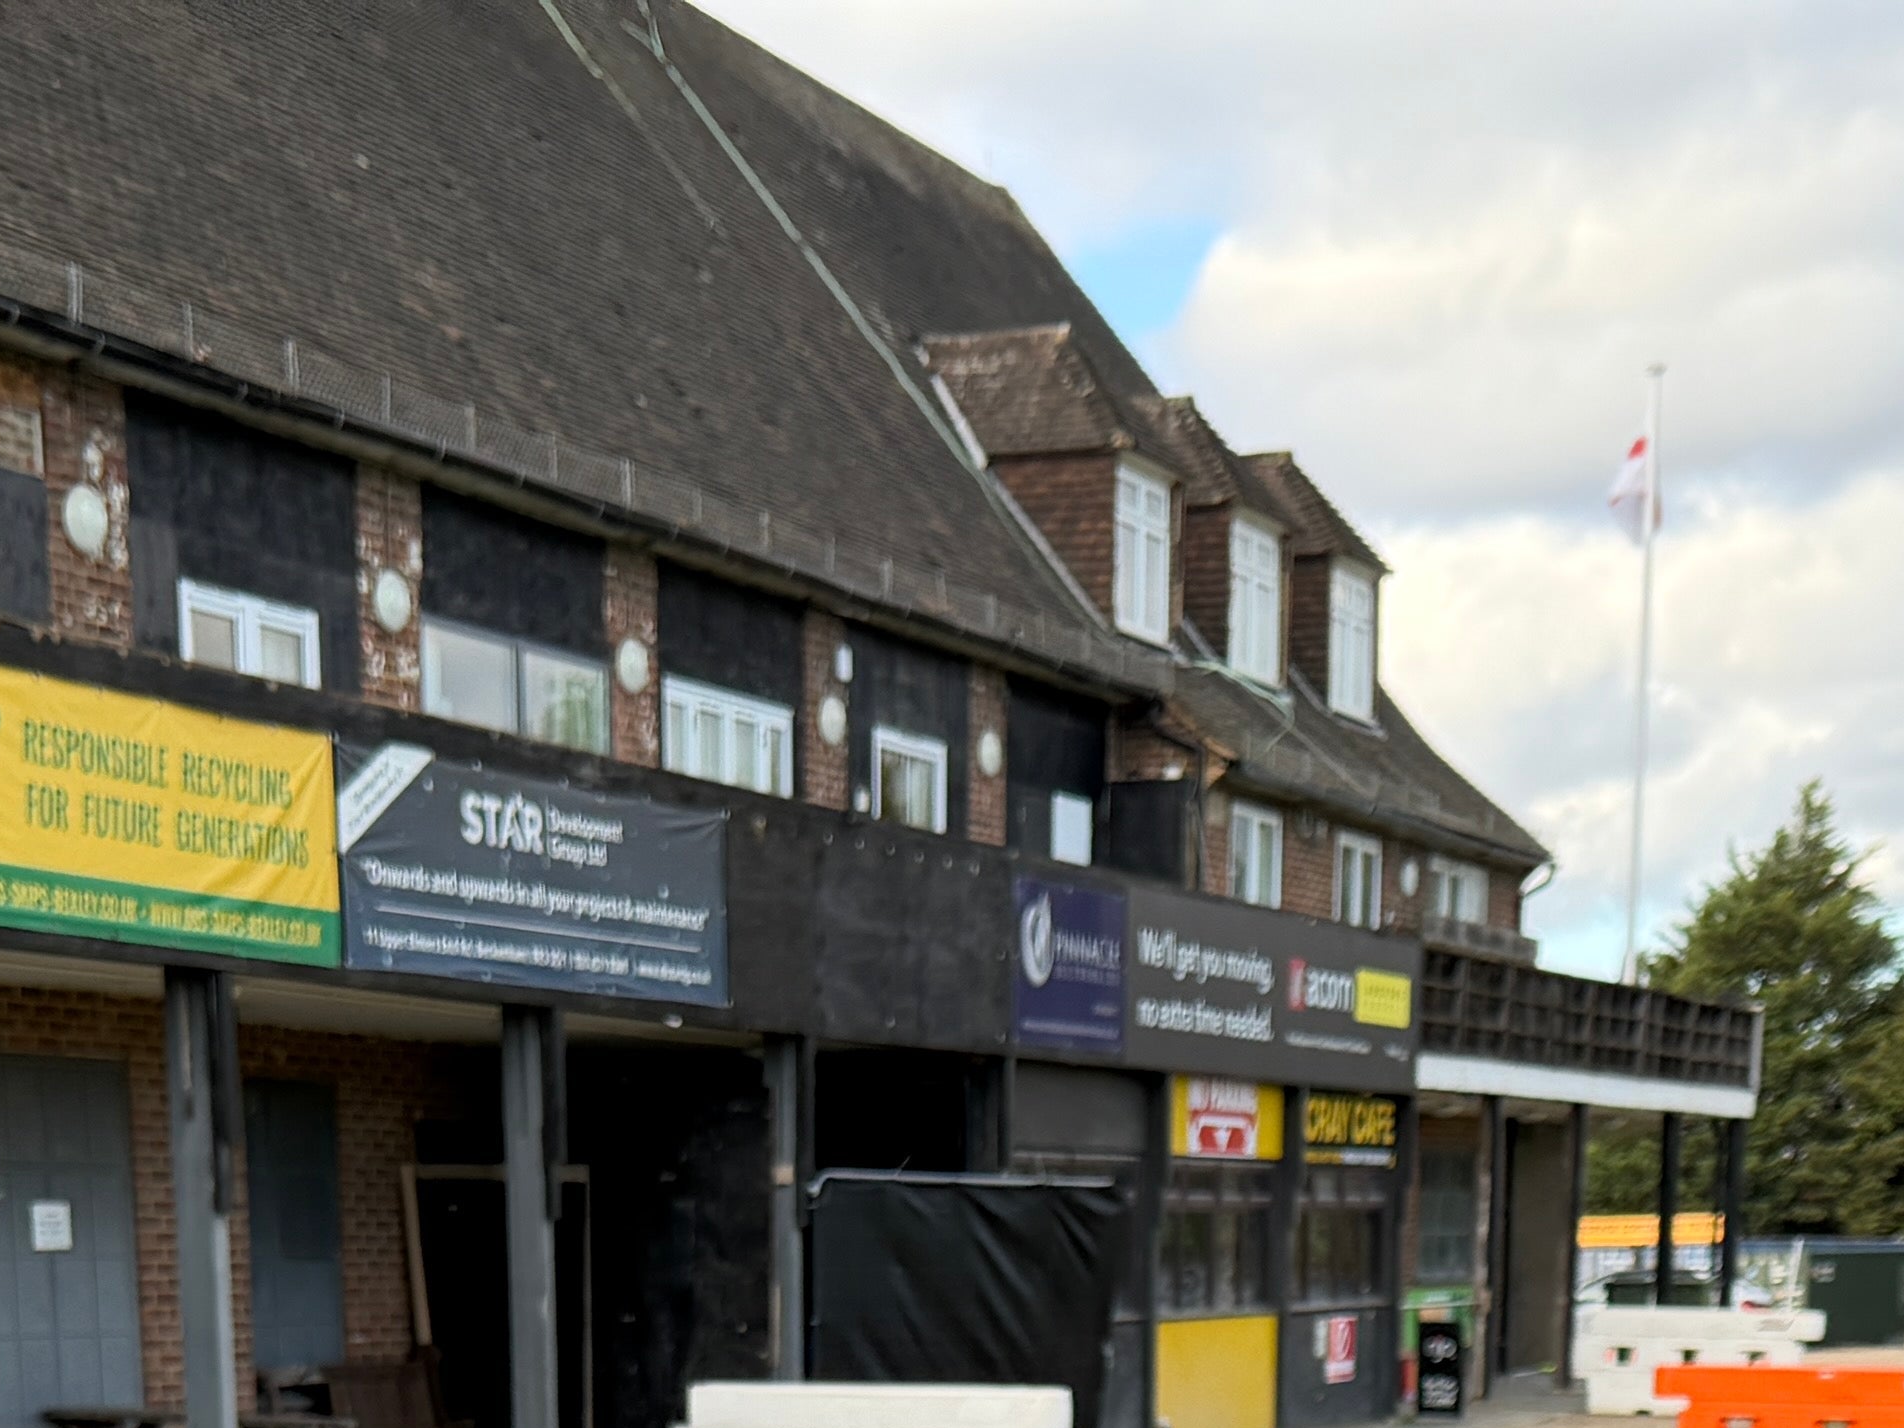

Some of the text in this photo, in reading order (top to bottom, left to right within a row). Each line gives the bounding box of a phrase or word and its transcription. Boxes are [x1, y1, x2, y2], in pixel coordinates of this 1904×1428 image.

[23, 718, 168, 789] RESPONSIBLE
[182, 747, 293, 810] RECYCLING
[25, 782, 309, 870] FOR FUTURE GENERATIONS
[460, 789, 545, 856] STAR
[548, 836, 587, 870] Group
[430, 867, 458, 897] and
[459, 874, 515, 906] upwards
[1137, 926, 1177, 969] We'll
[1173, 941, 1200, 981] get
[1197, 944, 1226, 984] you
[1136, 998, 1158, 1029] no
[1304, 1096, 1396, 1146] CRAY CAFE
